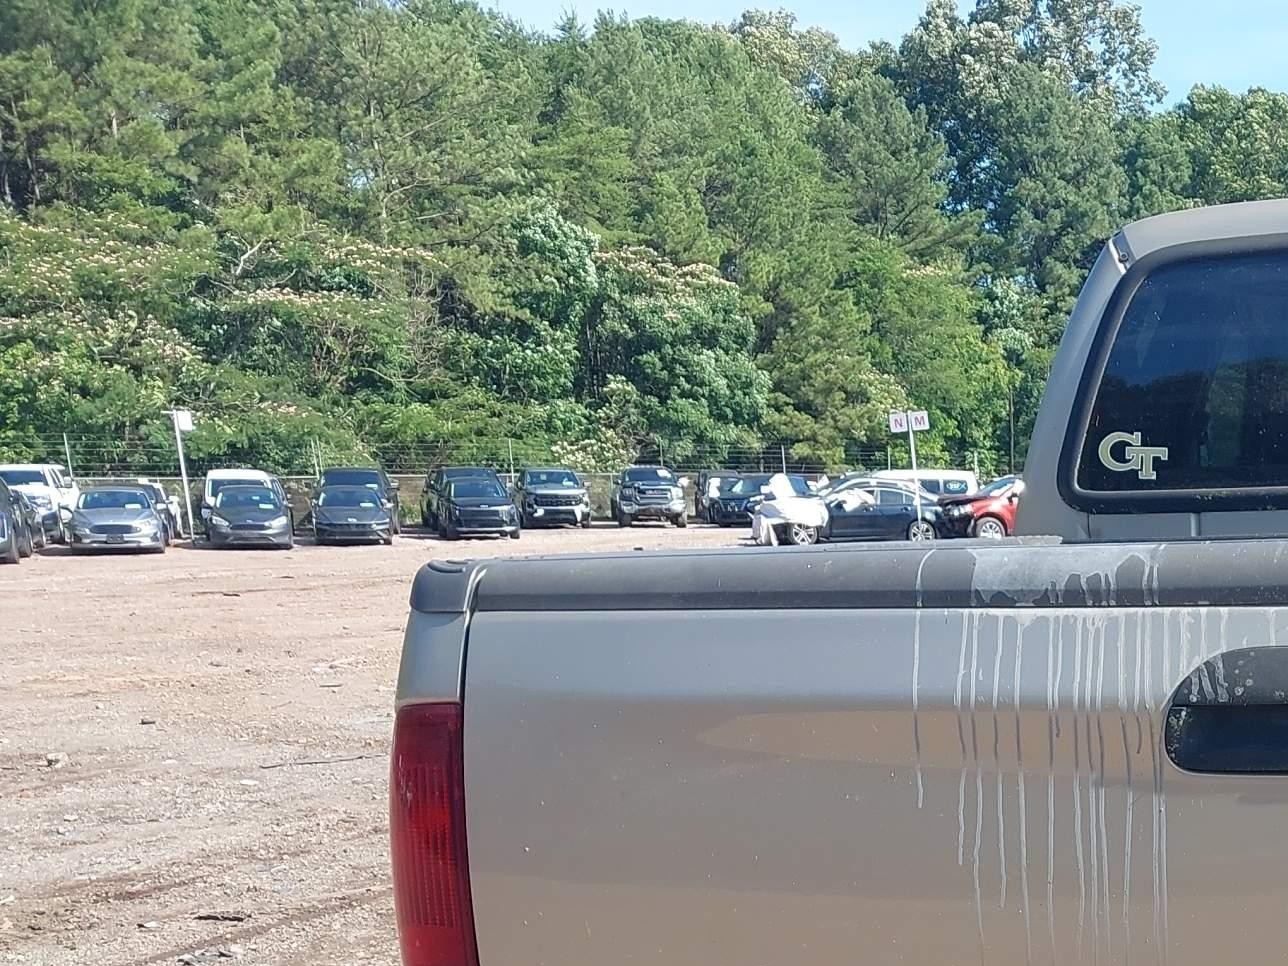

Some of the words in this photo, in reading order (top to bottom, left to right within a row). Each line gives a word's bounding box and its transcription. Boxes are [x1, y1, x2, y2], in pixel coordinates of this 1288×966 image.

[894, 418, 903, 428] N
[914, 415, 926, 427] M
[1098, 431, 1169, 480] GT
